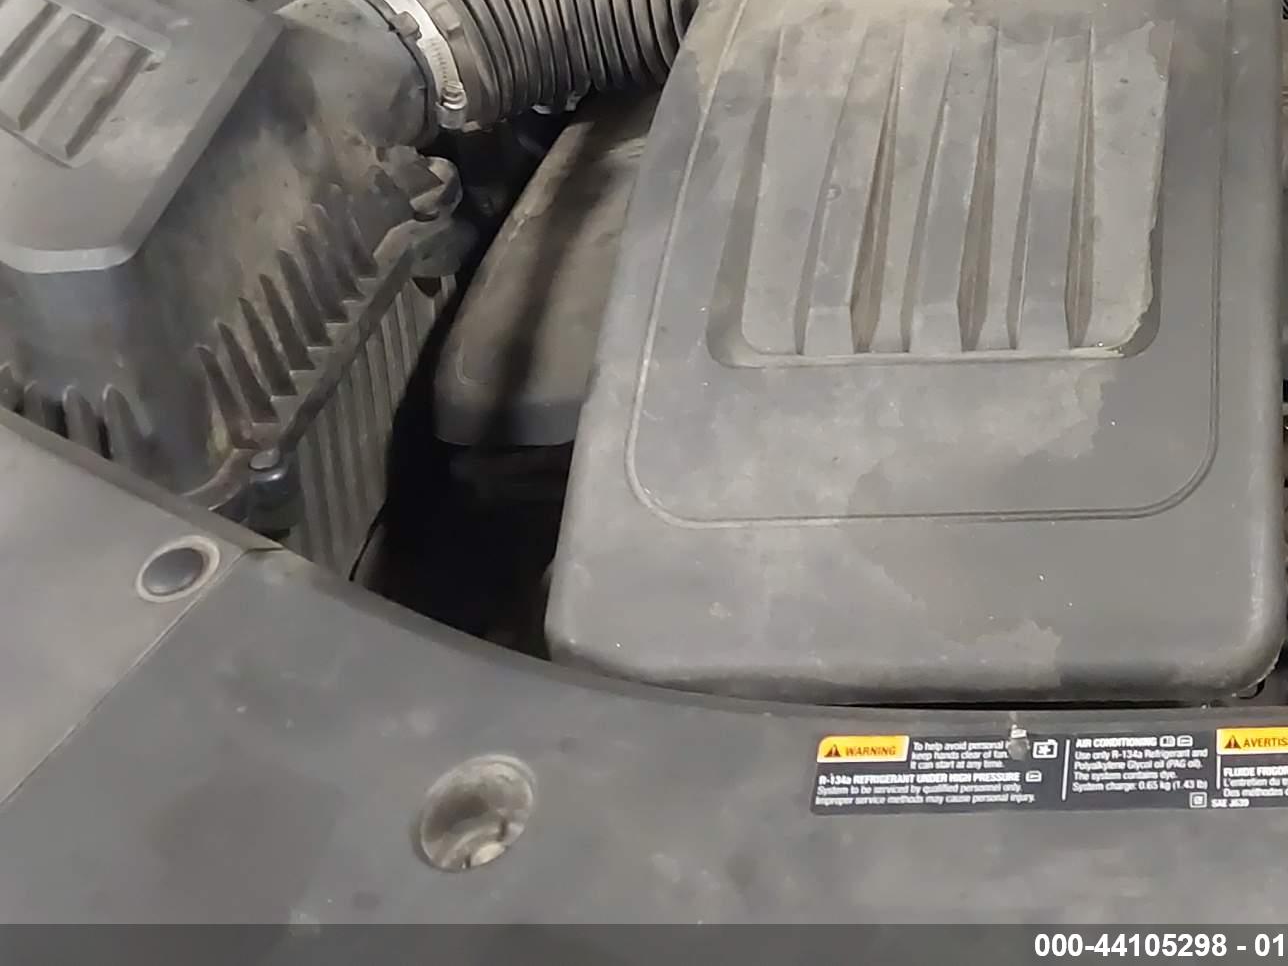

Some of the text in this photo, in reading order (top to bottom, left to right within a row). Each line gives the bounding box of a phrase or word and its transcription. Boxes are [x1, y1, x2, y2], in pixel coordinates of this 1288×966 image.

[1076, 736, 1157, 748] AIR CONDITIONING
[846, 746, 897, 756] WARNING
[853, 774, 915, 784] REFRIGERANT
[916, 773, 948, 783] UNDER
[949, 773, 971, 783] HIGH
[973, 772, 1020, 782] PRESSURE
[1211, 799, 1227, 807] SAE
